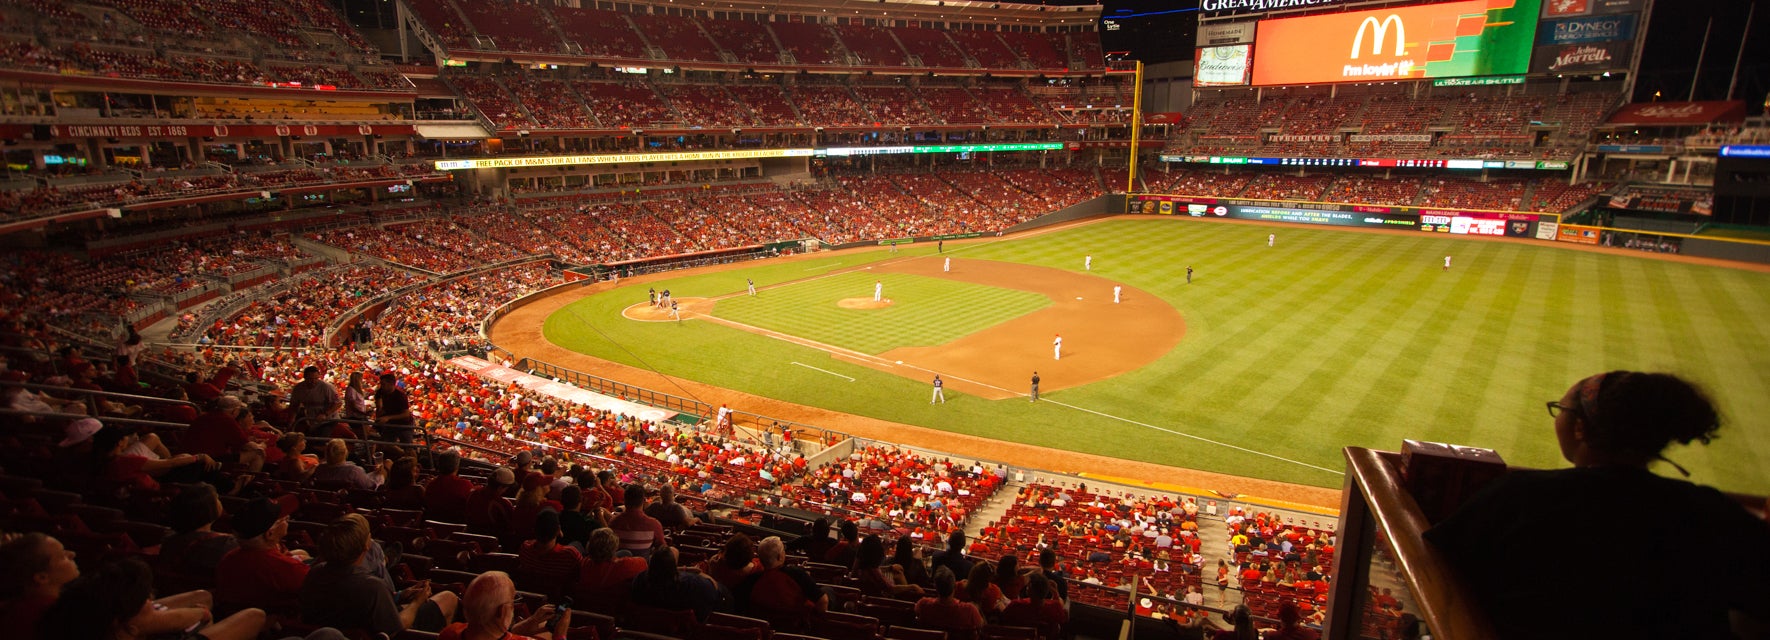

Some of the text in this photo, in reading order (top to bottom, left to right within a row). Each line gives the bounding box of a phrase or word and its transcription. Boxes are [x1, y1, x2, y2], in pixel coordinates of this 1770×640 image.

[1568, 21, 1620, 33] DYNEGY
[1574, 46, 1597, 55] John
[1548, 49, 1606, 70] Morrell
[1343, 65, 1362, 77] I'm
[68, 126, 188, 137] CINCINNATI REDS EST. 1869
